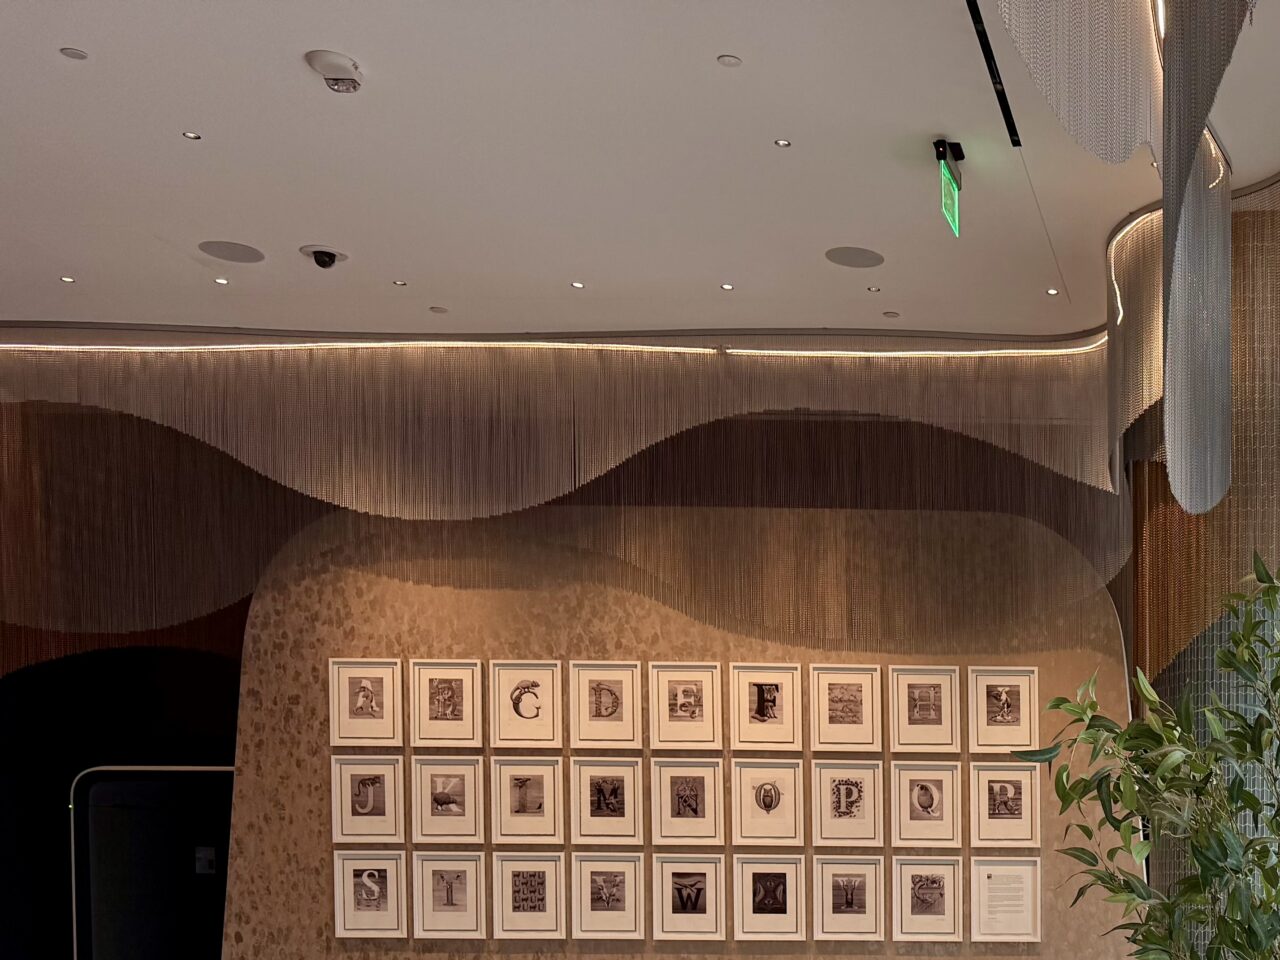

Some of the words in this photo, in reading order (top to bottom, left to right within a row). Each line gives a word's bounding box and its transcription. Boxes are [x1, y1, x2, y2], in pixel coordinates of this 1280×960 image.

[592, 686, 620, 718] D
[673, 684, 699, 717] E
[752, 683, 779, 718] F
[912, 689, 939, 719] H
[355, 781, 374, 814] J
[513, 778, 542, 814] L
[755, 782, 781, 811] O
[837, 785, 859, 812] P
[911, 783, 940, 817] Q
[989, 783, 1019, 814] R
[361, 870, 380, 900] S
[674, 887, 704, 911] W
